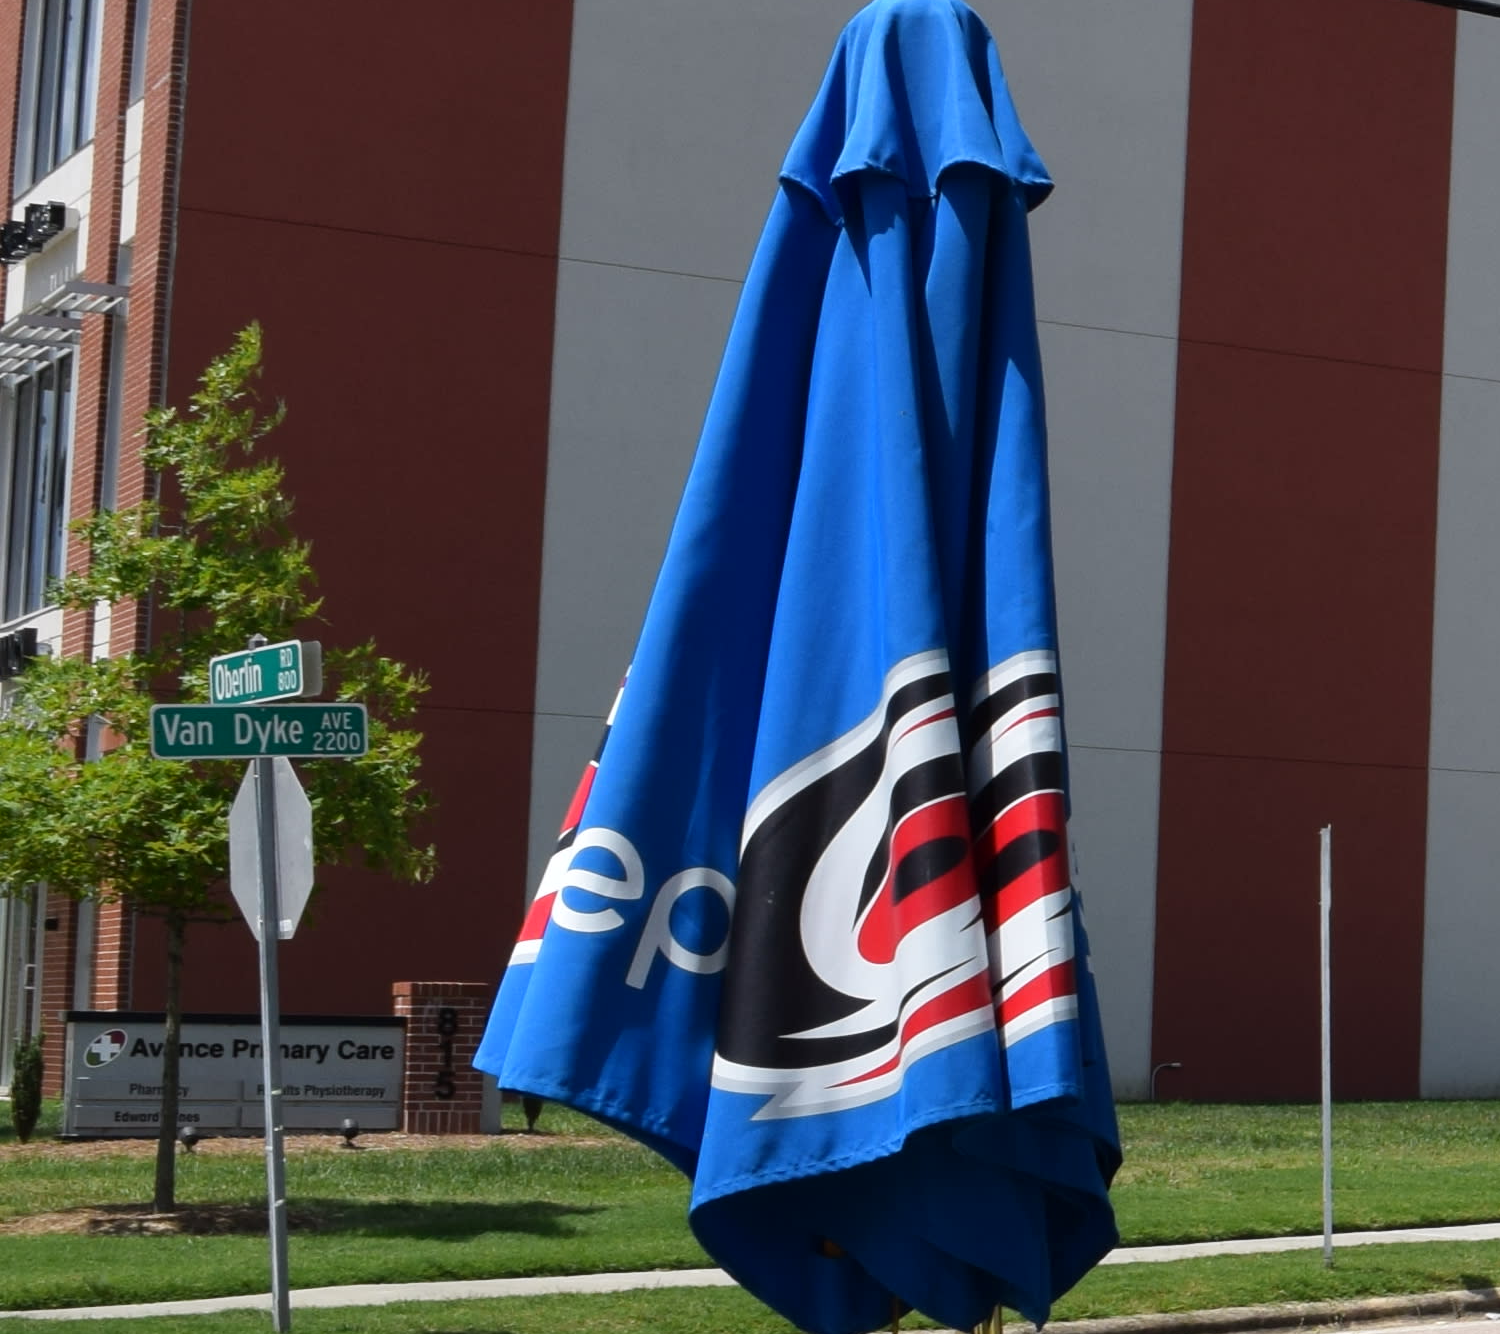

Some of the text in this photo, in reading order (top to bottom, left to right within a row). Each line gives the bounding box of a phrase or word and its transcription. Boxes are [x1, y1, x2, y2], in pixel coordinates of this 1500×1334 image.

[215, 648, 293, 701] Oberlin RD
[277, 669, 297, 691] 800
[160, 712, 353, 753] Van Dyke AVE
[312, 732, 361, 751] 2200
[130, 1038, 224, 1059] Avnce
[337, 1040, 395, 1060] Care
[129, 1083, 190, 1098] Pharcy
[304, 1084, 386, 1098] Physiotherapy
[114, 1111, 159, 1123] Edward
